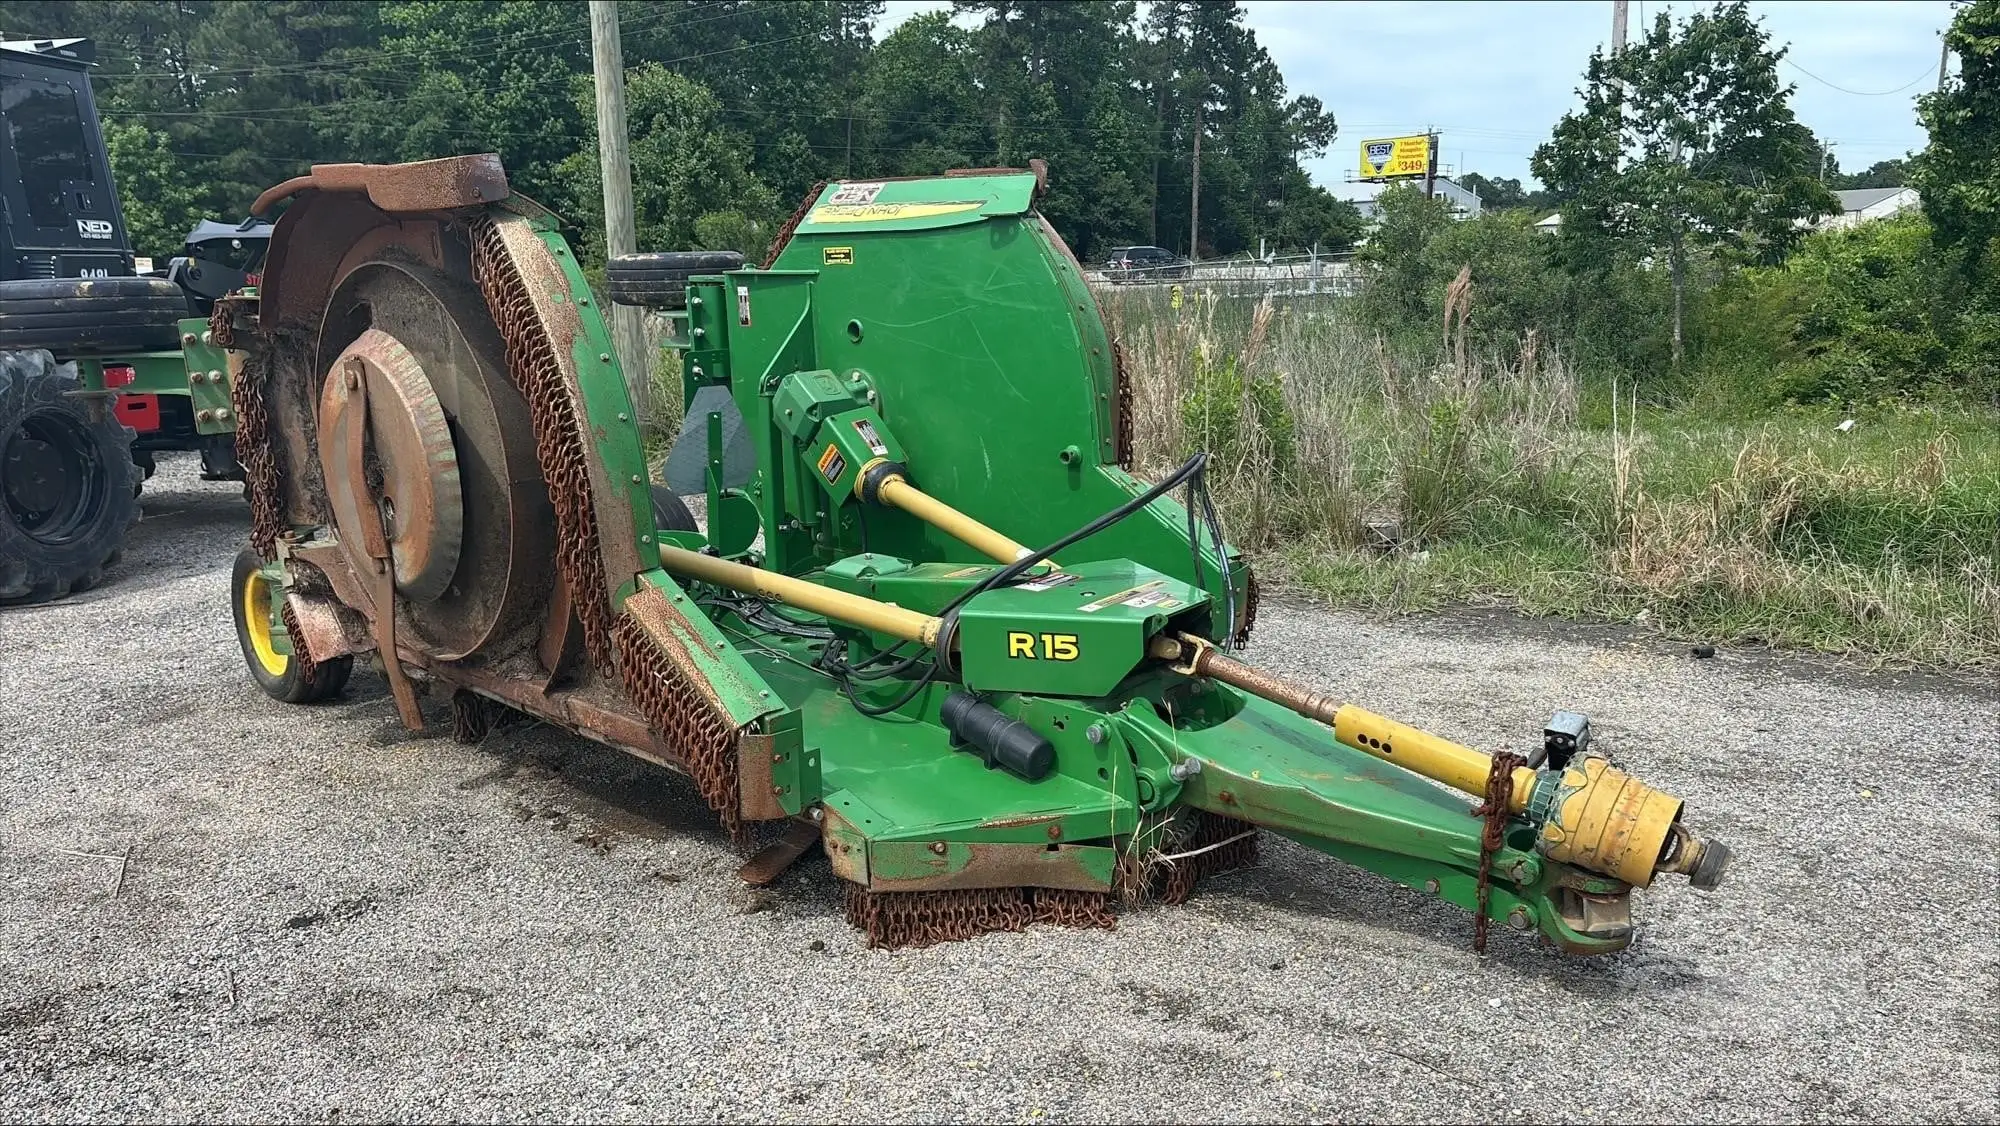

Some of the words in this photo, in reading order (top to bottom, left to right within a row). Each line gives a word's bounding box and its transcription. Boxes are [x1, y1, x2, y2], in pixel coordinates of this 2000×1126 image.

[1369, 145, 1391, 155] BEST
[867, 205, 908, 217] JOHN
[76, 219, 113, 234] NED
